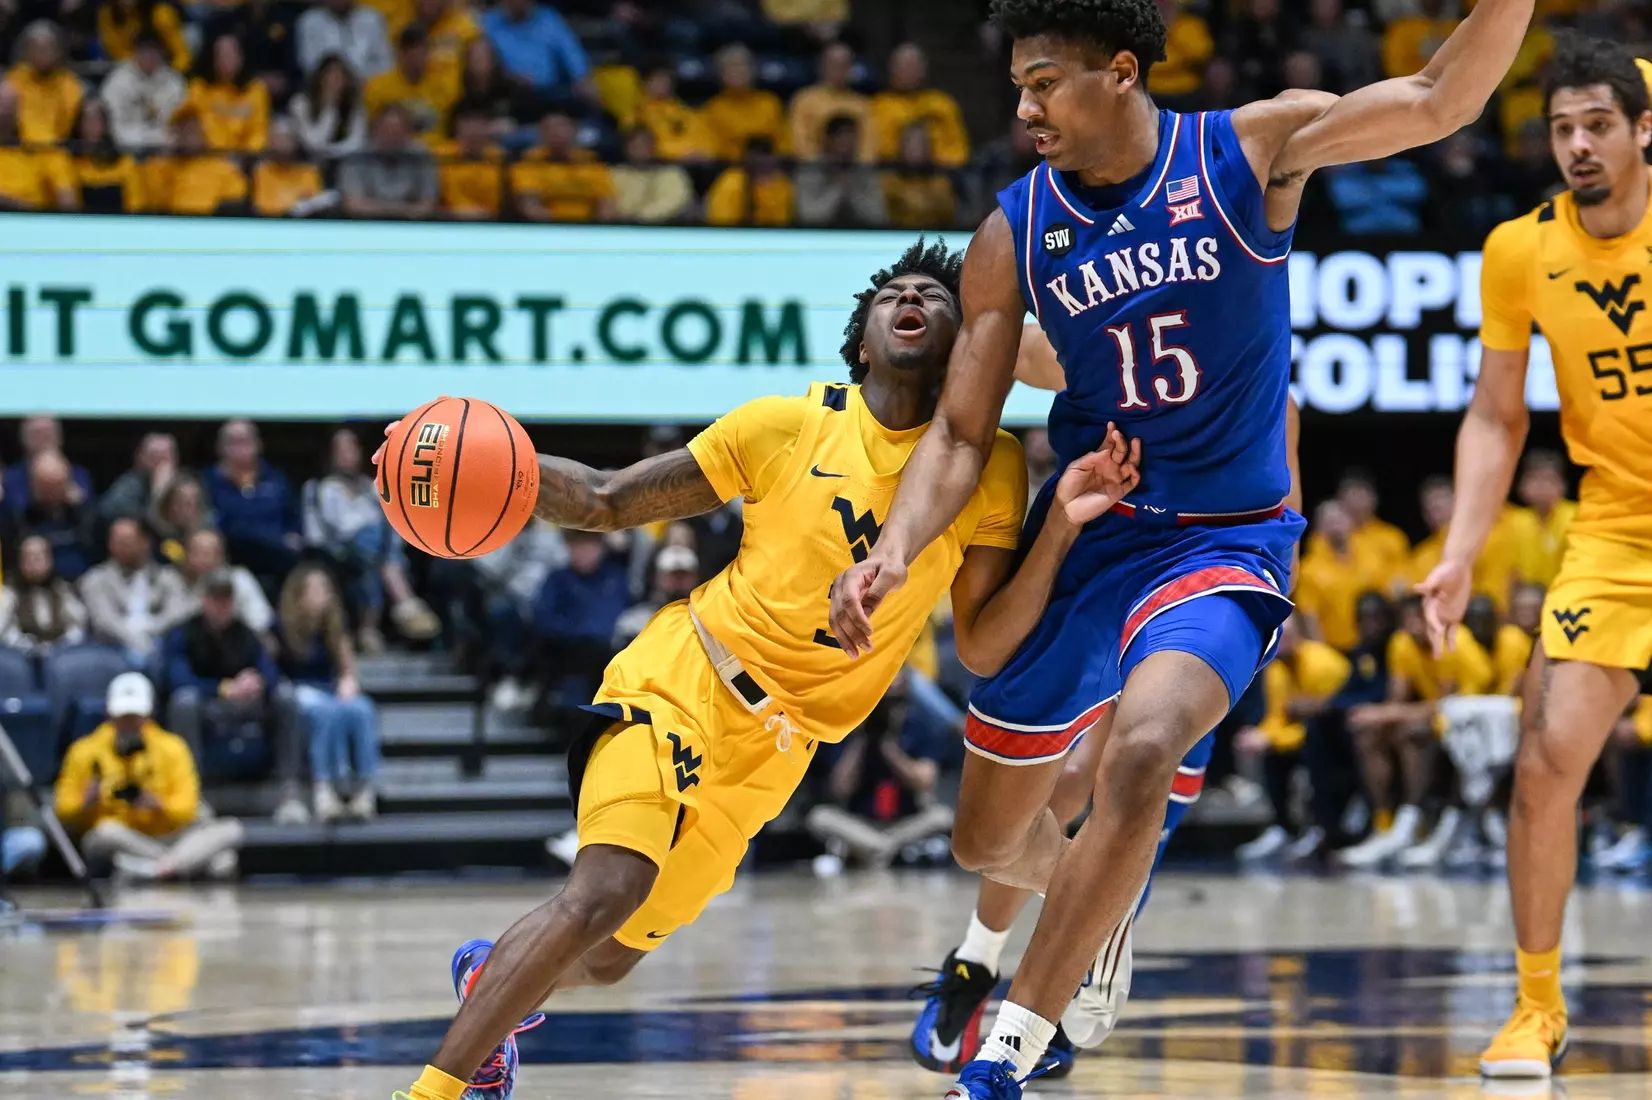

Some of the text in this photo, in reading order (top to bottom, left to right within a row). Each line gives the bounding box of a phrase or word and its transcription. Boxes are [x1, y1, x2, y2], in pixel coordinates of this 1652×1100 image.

[1045, 228, 1070, 250] SW
[1046, 236, 1221, 317] KANSAS
[8, 286, 808, 364] IT GOMART.COM
[1105, 310, 1203, 411] 15
[1587, 342, 1652, 401] 55
[410, 422, 443, 507] ELITE
